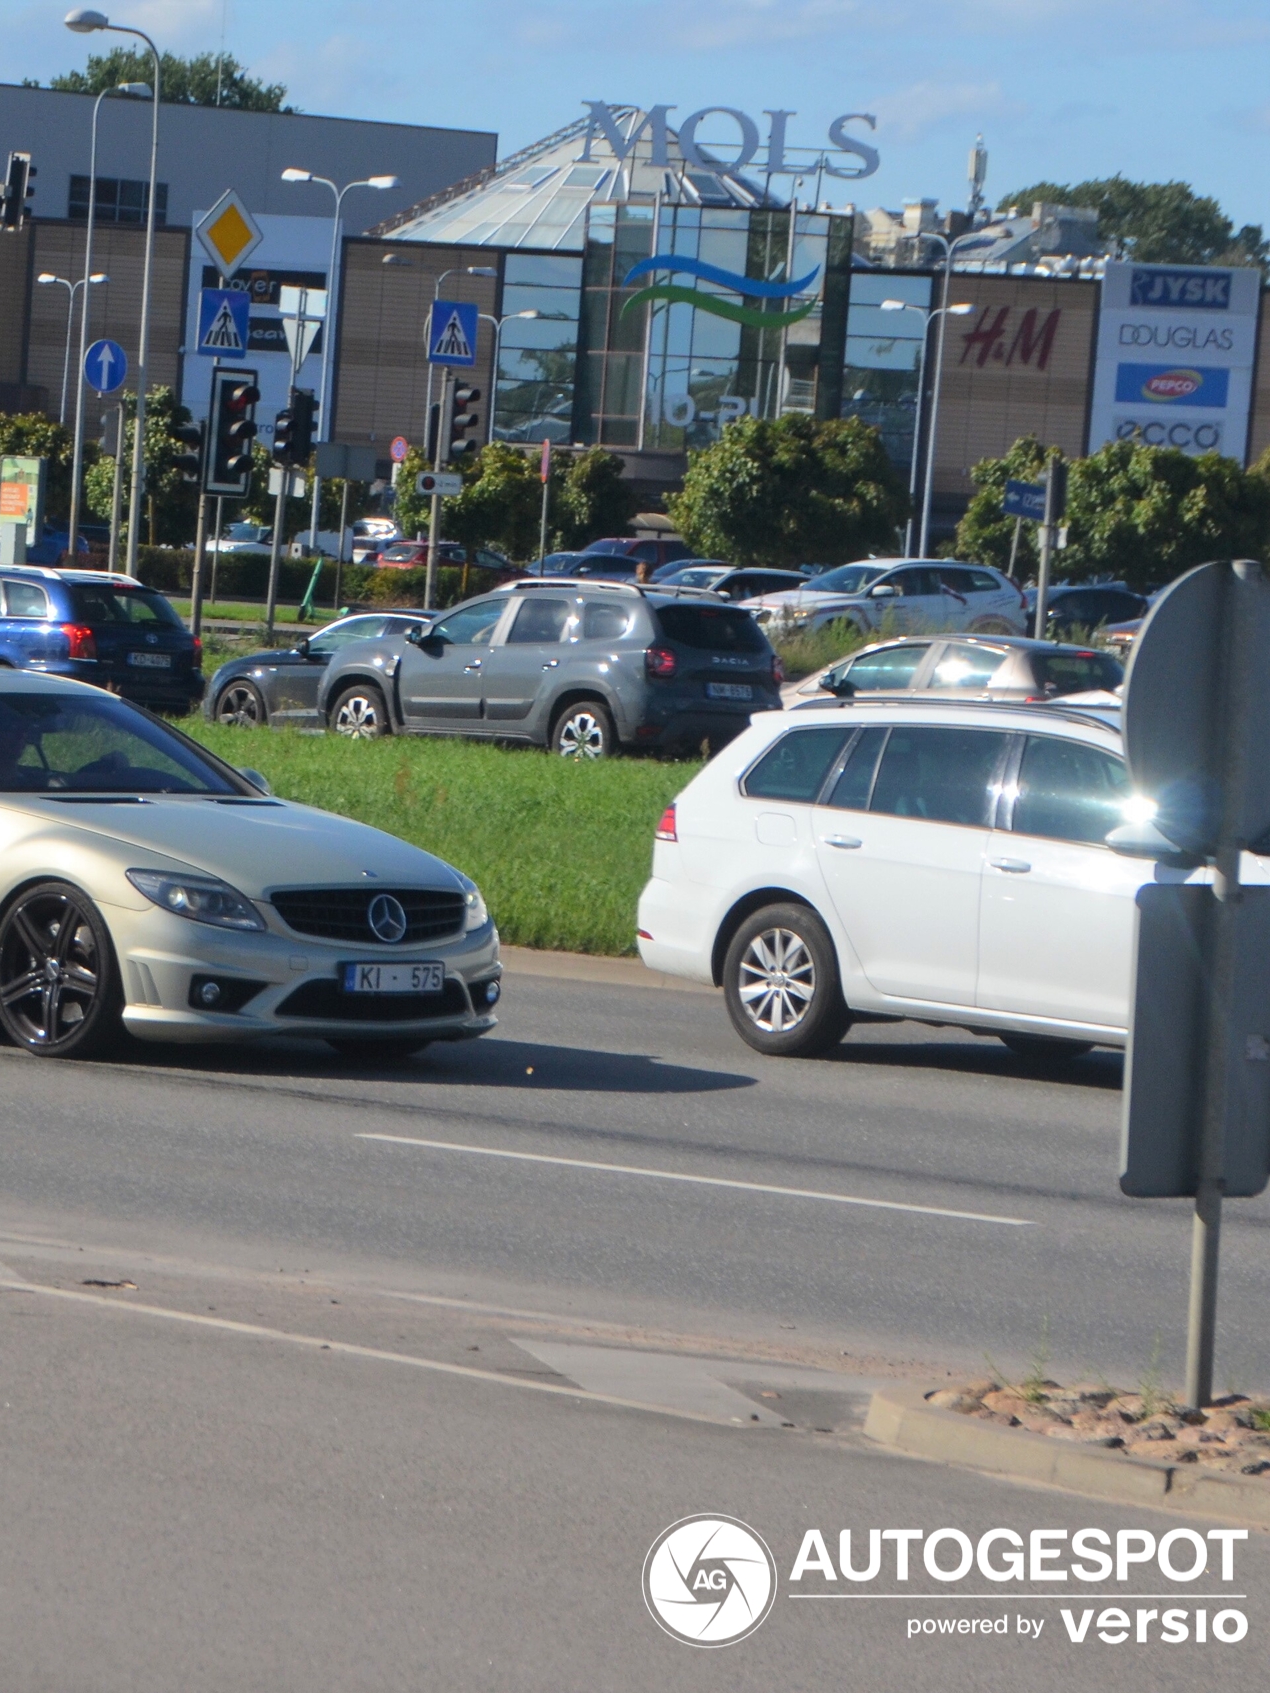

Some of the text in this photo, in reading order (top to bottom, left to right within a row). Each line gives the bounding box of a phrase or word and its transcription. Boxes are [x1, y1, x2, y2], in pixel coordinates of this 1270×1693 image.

[573, 100, 880, 179] MOLS
[1147, 276, 1228, 302] JYSK
[959, 306, 1061, 371] H&M
[1119, 323, 1234, 350] DOUGLAS
[1151, 379, 1197, 393] PEPCO
[1116, 420, 1220, 449] ecco
[712, 656, 750, 666] DACIA
